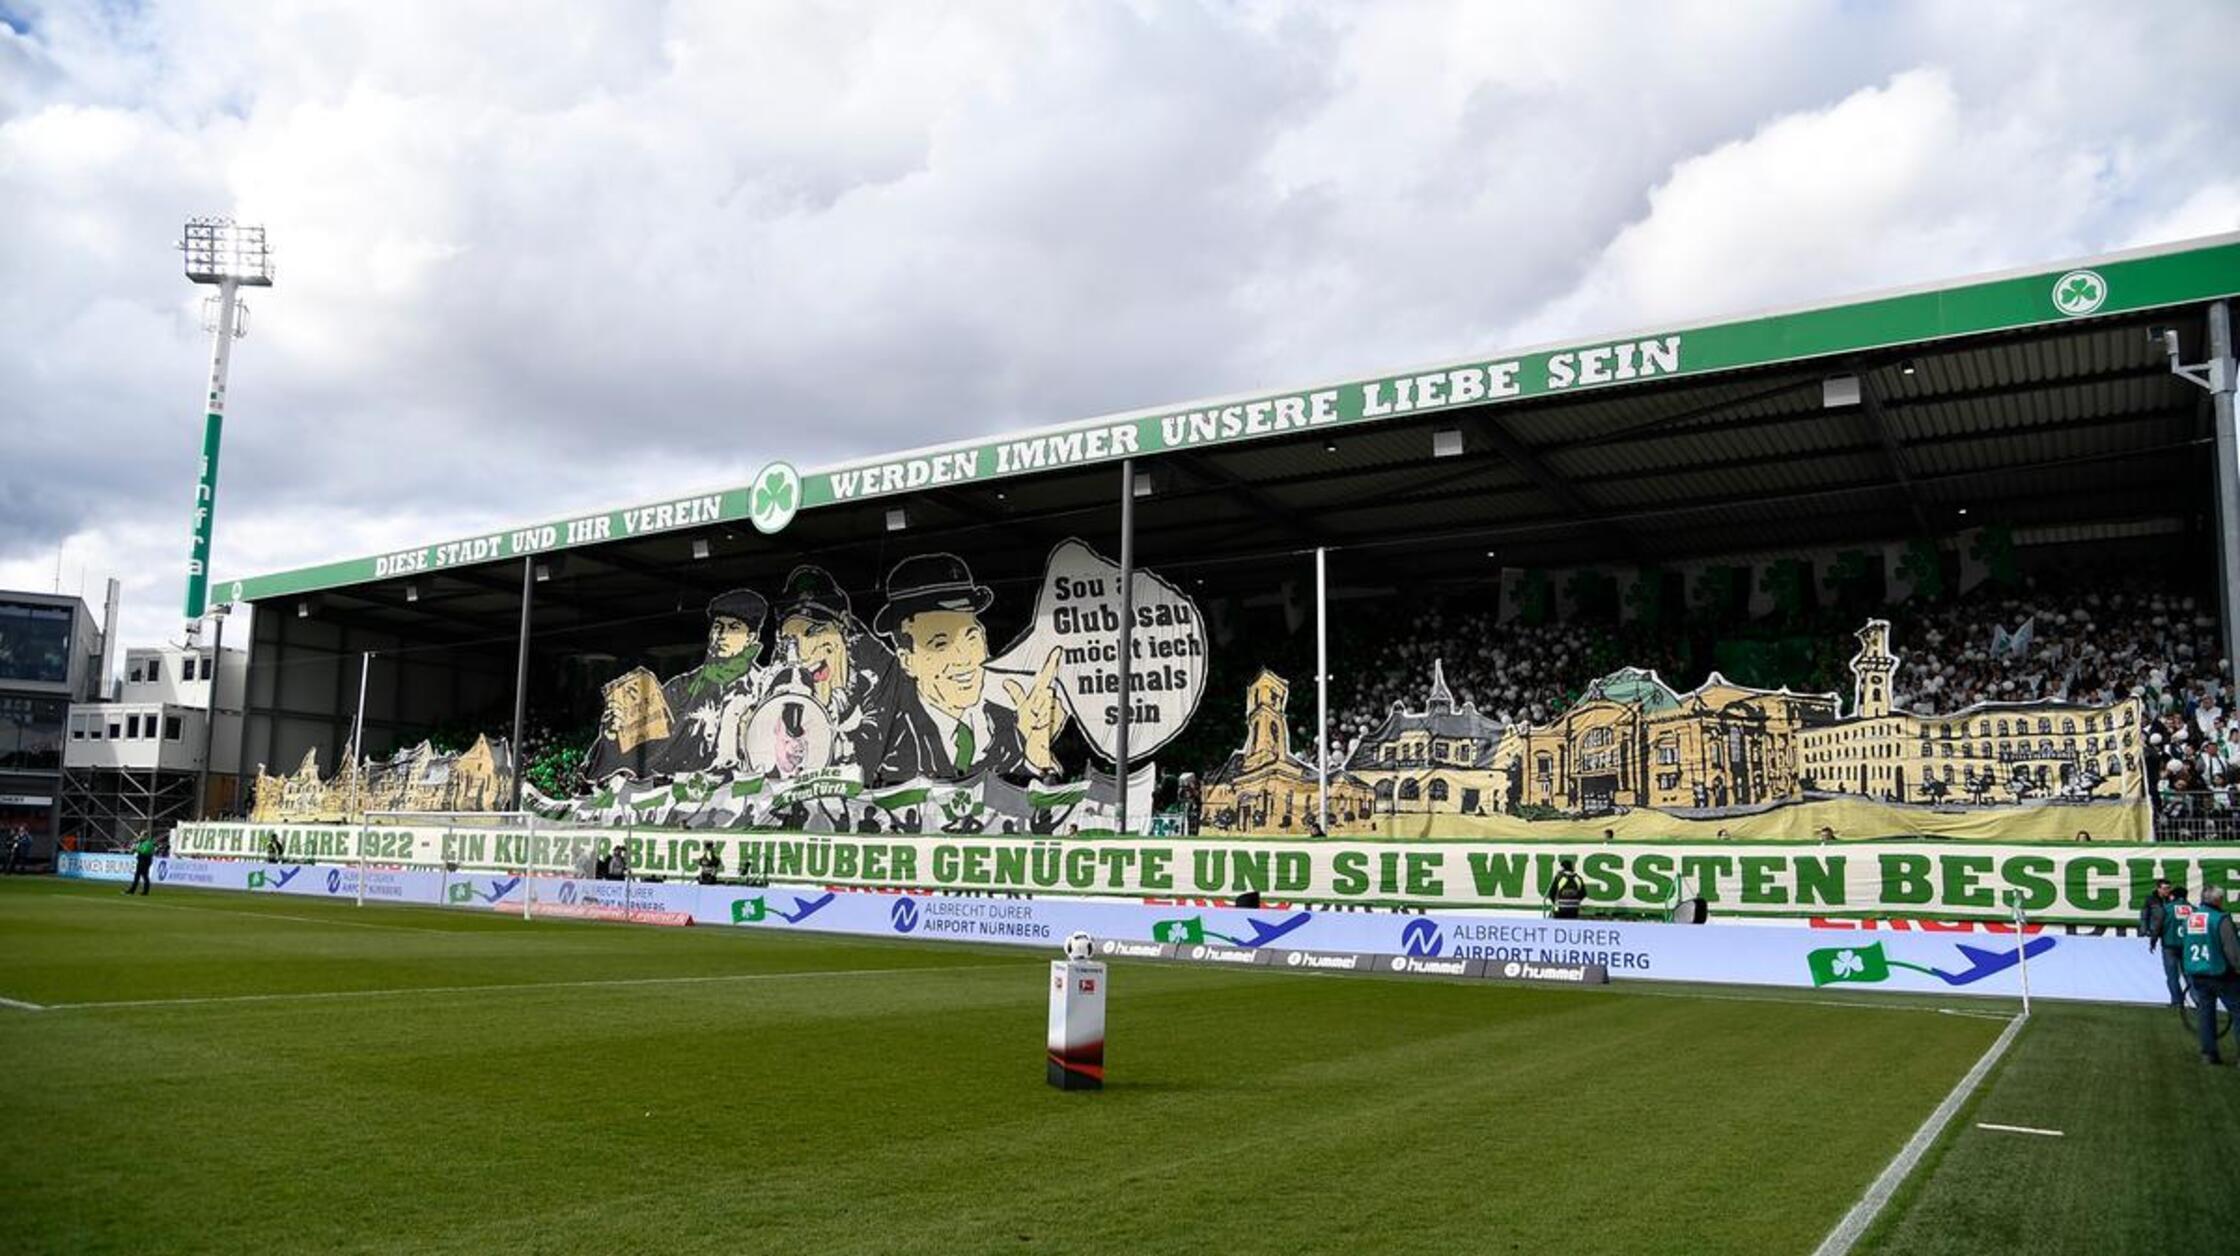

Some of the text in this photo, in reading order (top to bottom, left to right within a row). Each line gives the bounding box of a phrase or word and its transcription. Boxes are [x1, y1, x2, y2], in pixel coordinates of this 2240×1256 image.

[830, 336, 1682, 500] WERDEN IMMER UNSERE LIEBE SEIN
[188, 455, 210, 576] infra
[375, 495, 721, 577] DIESE STADT UND IHR VEREIN
[1055, 576, 1104, 601] Sou
[1150, 634, 1201, 659] iech
[1078, 665, 1188, 694] niemals
[249, 829, 277, 853] IM
[281, 830, 350, 856] JAHRE
[356, 831, 414, 859] 1922
[440, 833, 486, 862] EIN
[623, 837, 727, 872] BLICK
[738, 837, 918, 880] HINÜBER
[932, 841, 1174, 888] GENÜGTE
[1193, 849, 1312, 892] UND
[1332, 850, 1445, 896] SIE
[925, 902, 986, 917] ALBRECHT
[923, 919, 976, 934] AIRPORT
[1453, 924, 1549, 943] ALBRECHT
[1205, 948, 1257, 962] hummel
[1302, 953, 1358, 969] hummel
[1453, 945, 1533, 962] AIRPORT
[2190, 944, 2210, 961] 24
[1407, 957, 1467, 975] hummel
[1521, 964, 1586, 982] hummel
